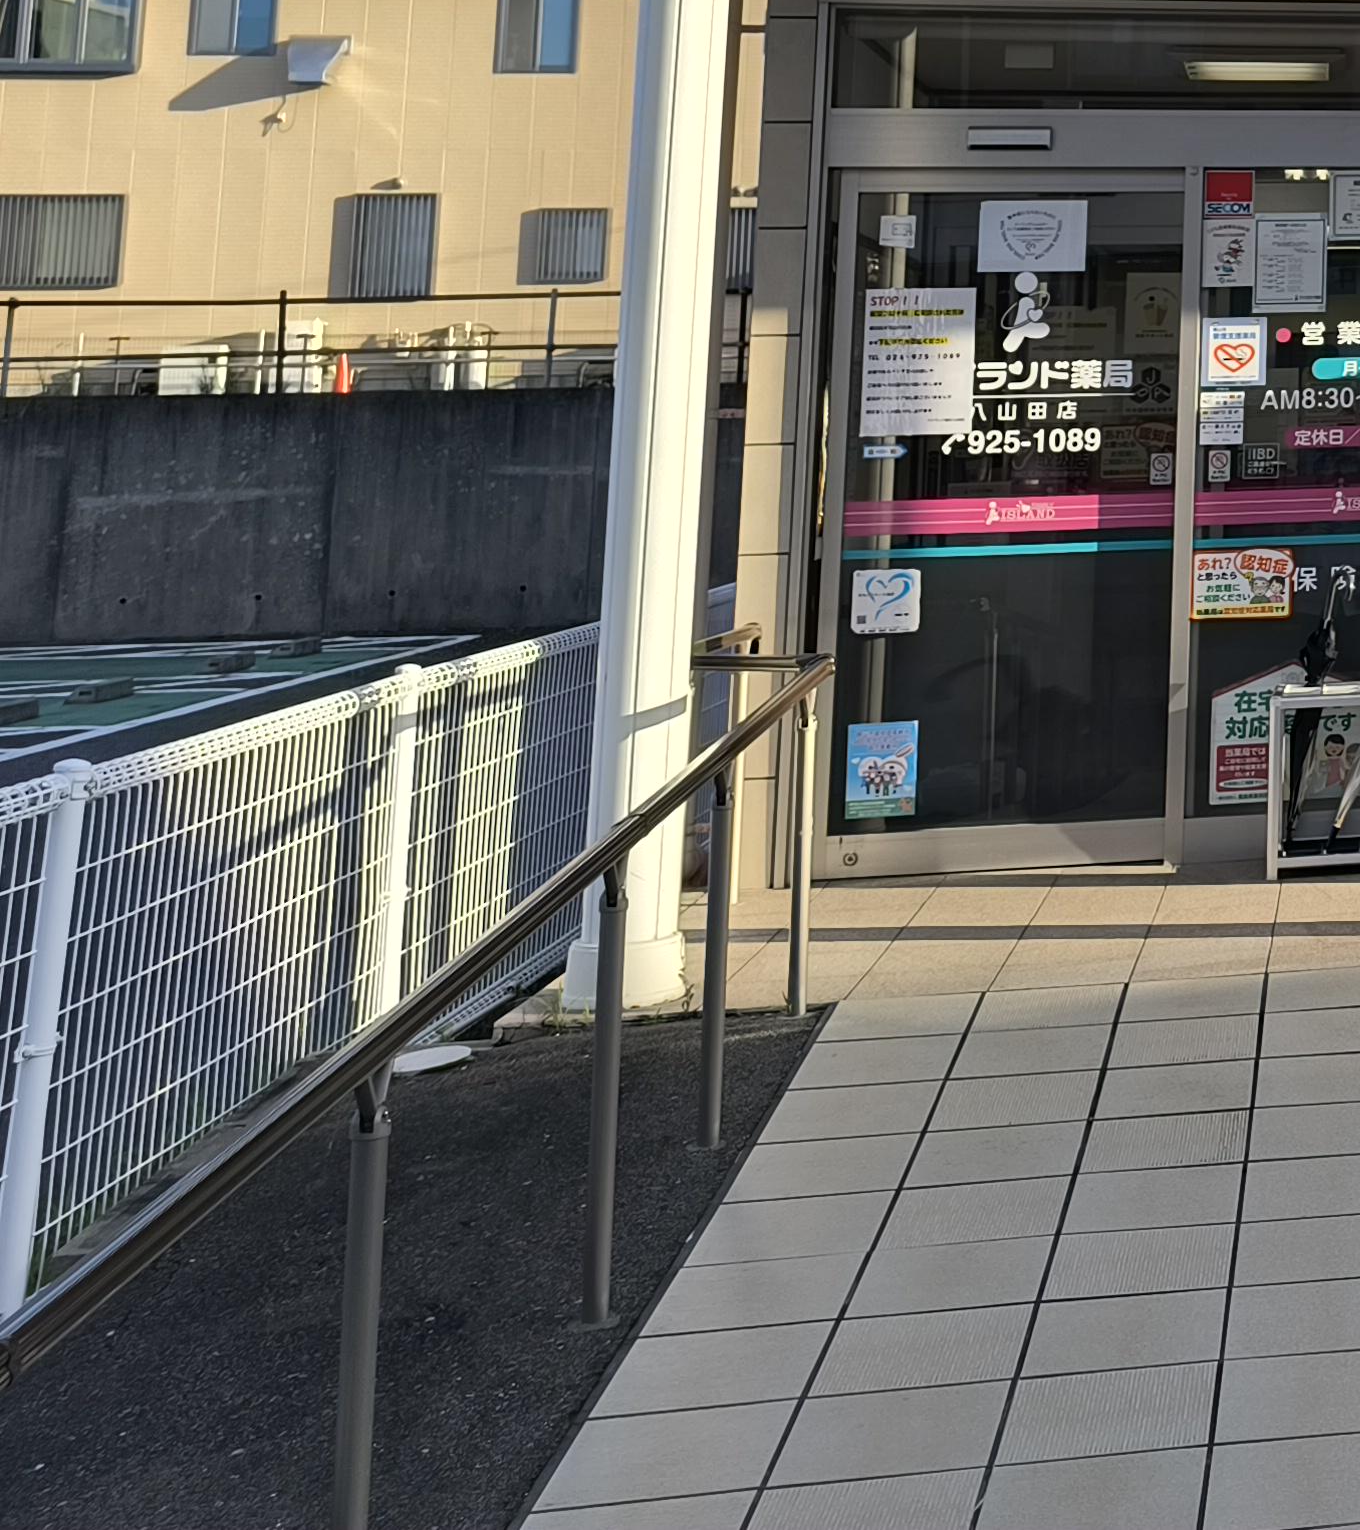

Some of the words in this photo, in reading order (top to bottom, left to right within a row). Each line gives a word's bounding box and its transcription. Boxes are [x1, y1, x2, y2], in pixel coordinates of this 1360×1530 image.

[1207, 203, 1250, 213] SECOM
[974, 359, 1134, 391] ランド薬局
[967, 427, 1101, 455] 925-1089
[1001, 508, 1056, 521] ISLAND
[1239, 553, 1290, 575] 認知症
